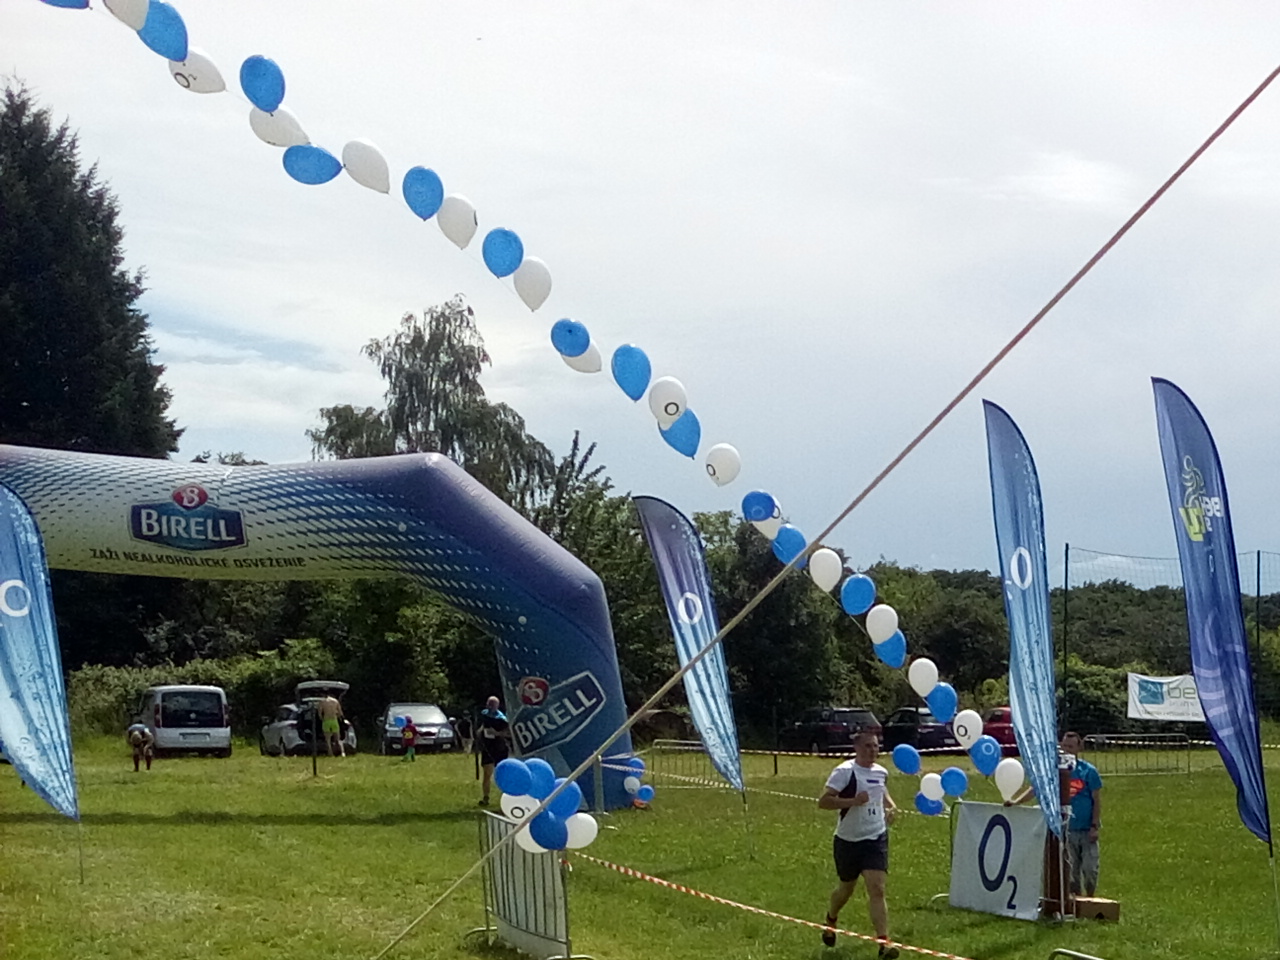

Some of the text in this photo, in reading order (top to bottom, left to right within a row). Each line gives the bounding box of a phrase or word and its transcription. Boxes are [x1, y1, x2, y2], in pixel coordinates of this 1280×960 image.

[140, 508, 237, 541] BIRELL
[514, 689, 597, 748] BIRELL
[978, 813, 1018, 910] O2
